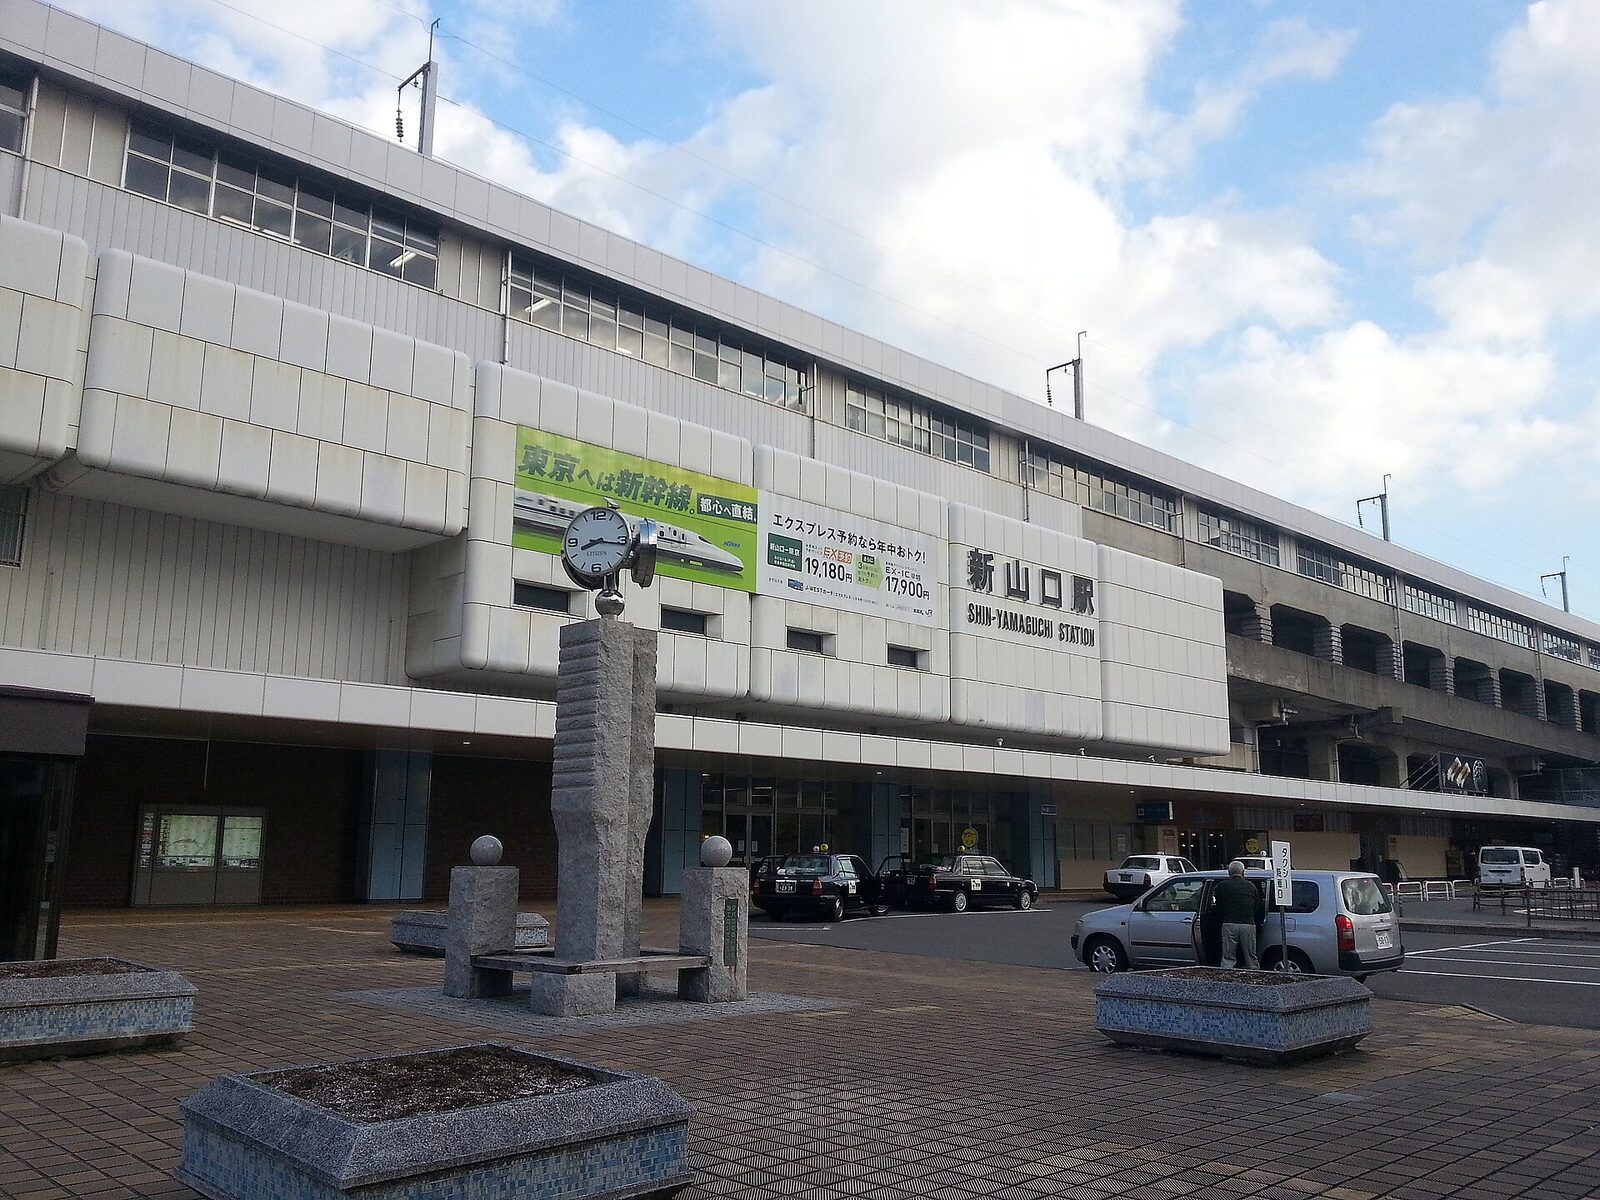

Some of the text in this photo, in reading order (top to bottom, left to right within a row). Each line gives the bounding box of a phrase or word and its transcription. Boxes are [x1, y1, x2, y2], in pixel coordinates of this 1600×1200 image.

[517, 444, 695, 515] 東京へは新幹線。
[591, 510, 607, 521] 12
[568, 538, 578, 547] 9
[617, 536, 628, 545] 3
[591, 563, 602, 573] 6
[805, 556, 853, 583] 19,180円
[885, 575, 930, 600] 17,900円
[966, 548, 1095, 616] 新山口駅
[967, 602, 1095, 648] SHIN-YAMAGUCHI STATION
